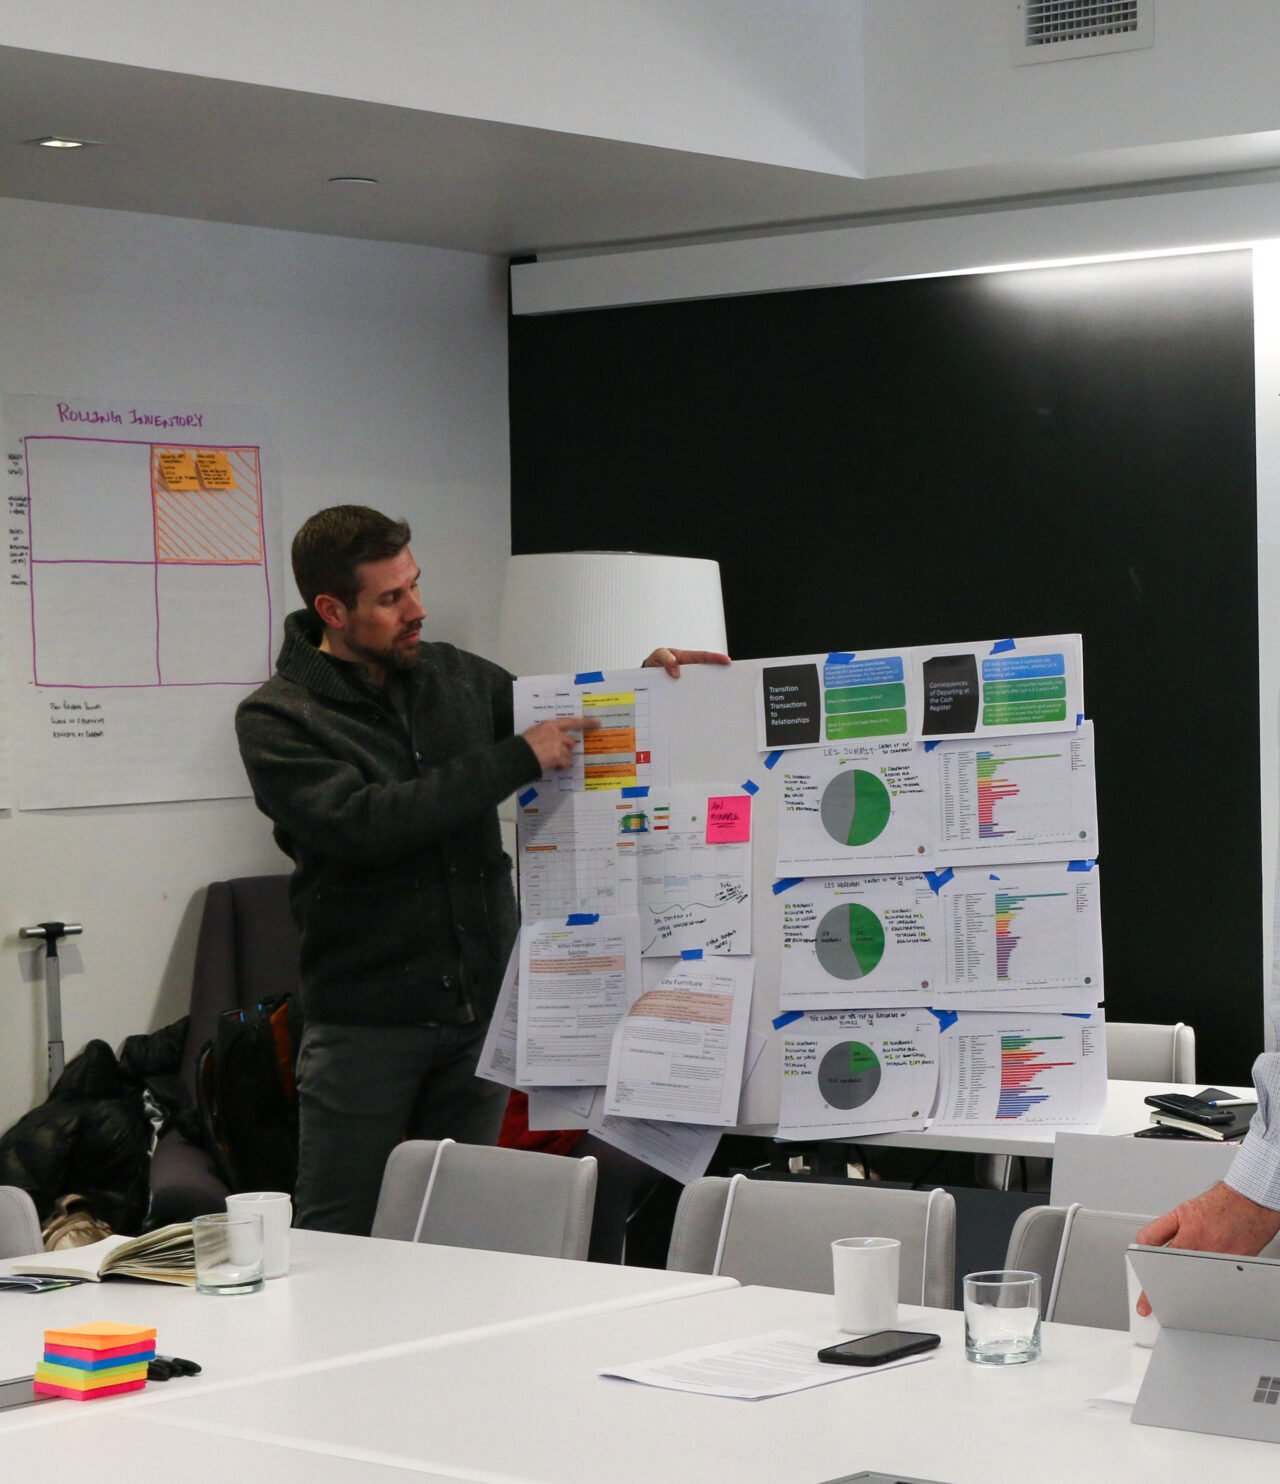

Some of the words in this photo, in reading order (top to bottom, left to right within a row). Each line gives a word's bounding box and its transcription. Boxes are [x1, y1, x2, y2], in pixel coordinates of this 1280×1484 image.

[57, 402, 122, 425] ROLLING
[128, 409, 203, 428] INVENTORY
[930, 681, 969, 689] Consequences
[936, 689, 963, 697] Departing
[771, 702, 807, 710] Transactions
[930, 704, 952, 712] Register
[771, 717, 810, 726] Relationships
